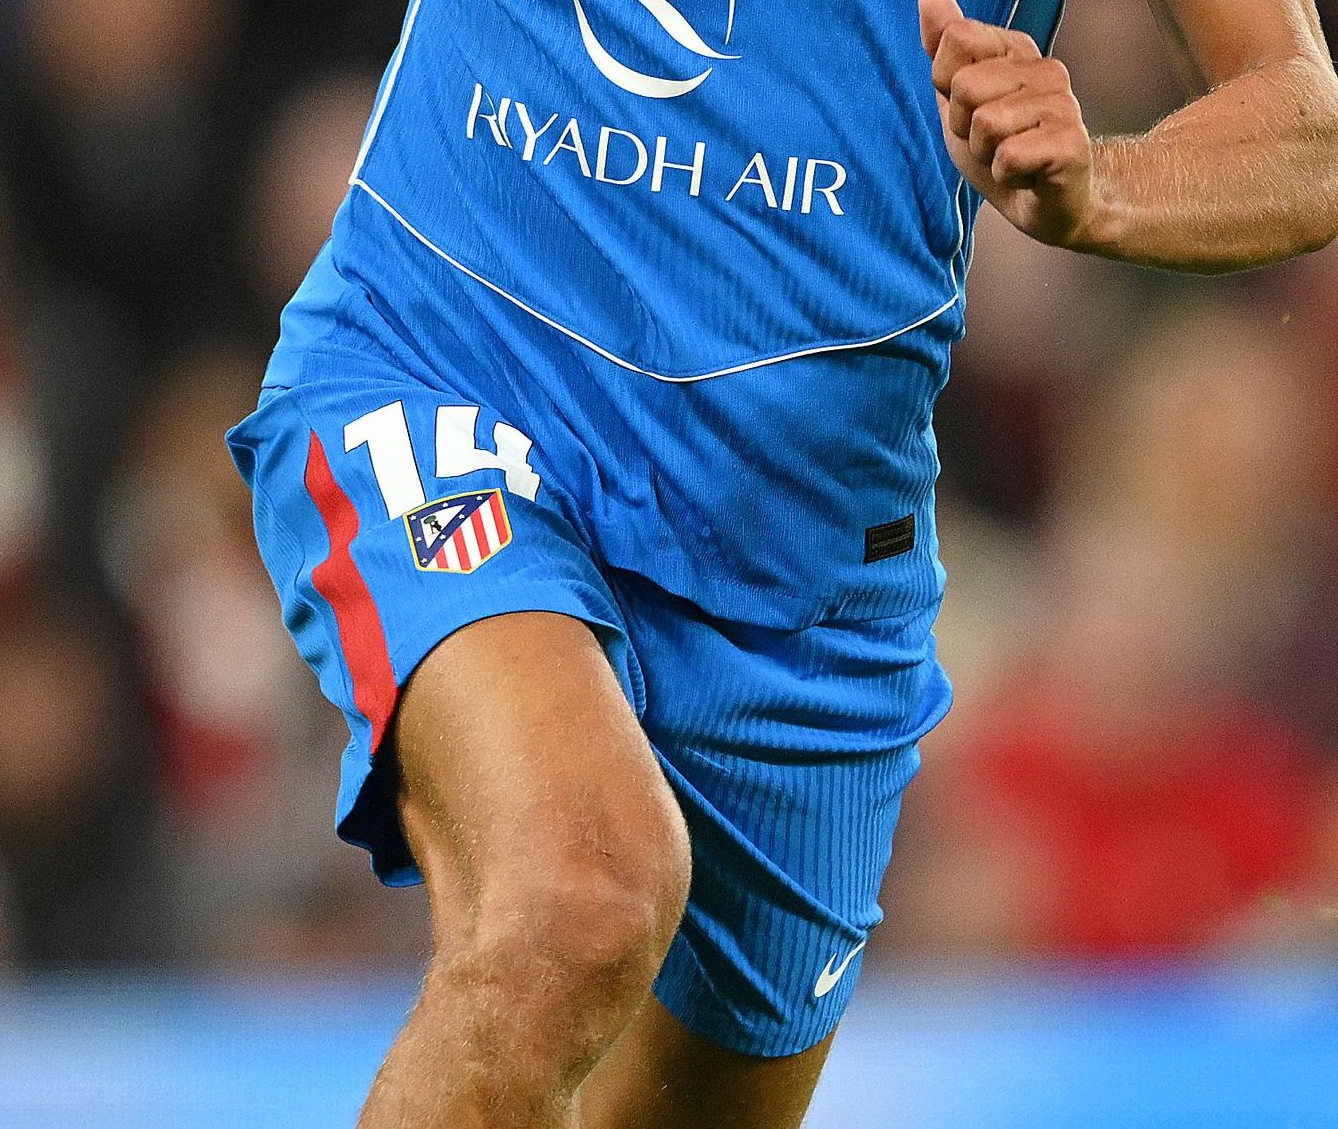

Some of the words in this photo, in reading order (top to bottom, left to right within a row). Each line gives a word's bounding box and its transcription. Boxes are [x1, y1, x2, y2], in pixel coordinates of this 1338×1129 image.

[465, 82, 707, 197] RIYADH
[724, 152, 847, 216] AIR
[343, 399, 541, 522] 14
